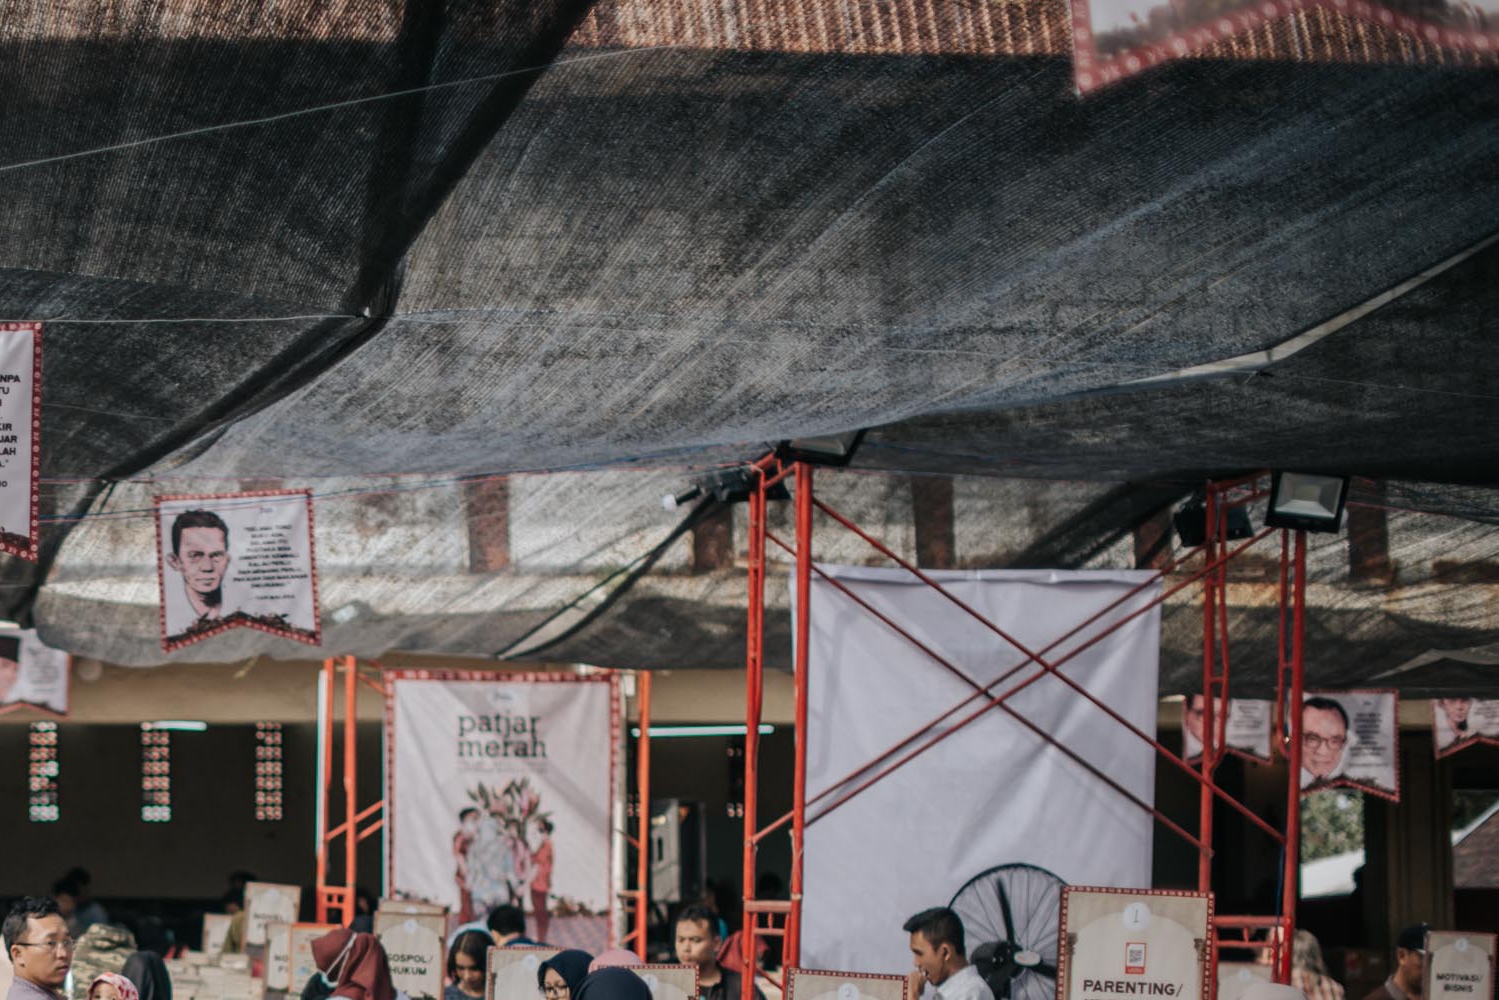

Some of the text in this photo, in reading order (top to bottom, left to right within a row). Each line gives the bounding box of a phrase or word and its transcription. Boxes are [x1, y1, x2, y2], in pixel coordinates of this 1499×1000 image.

[458, 709, 541, 738] patjar
[458, 733, 547, 758] merah
[1083, 979, 1183, 997] PARENTING/
